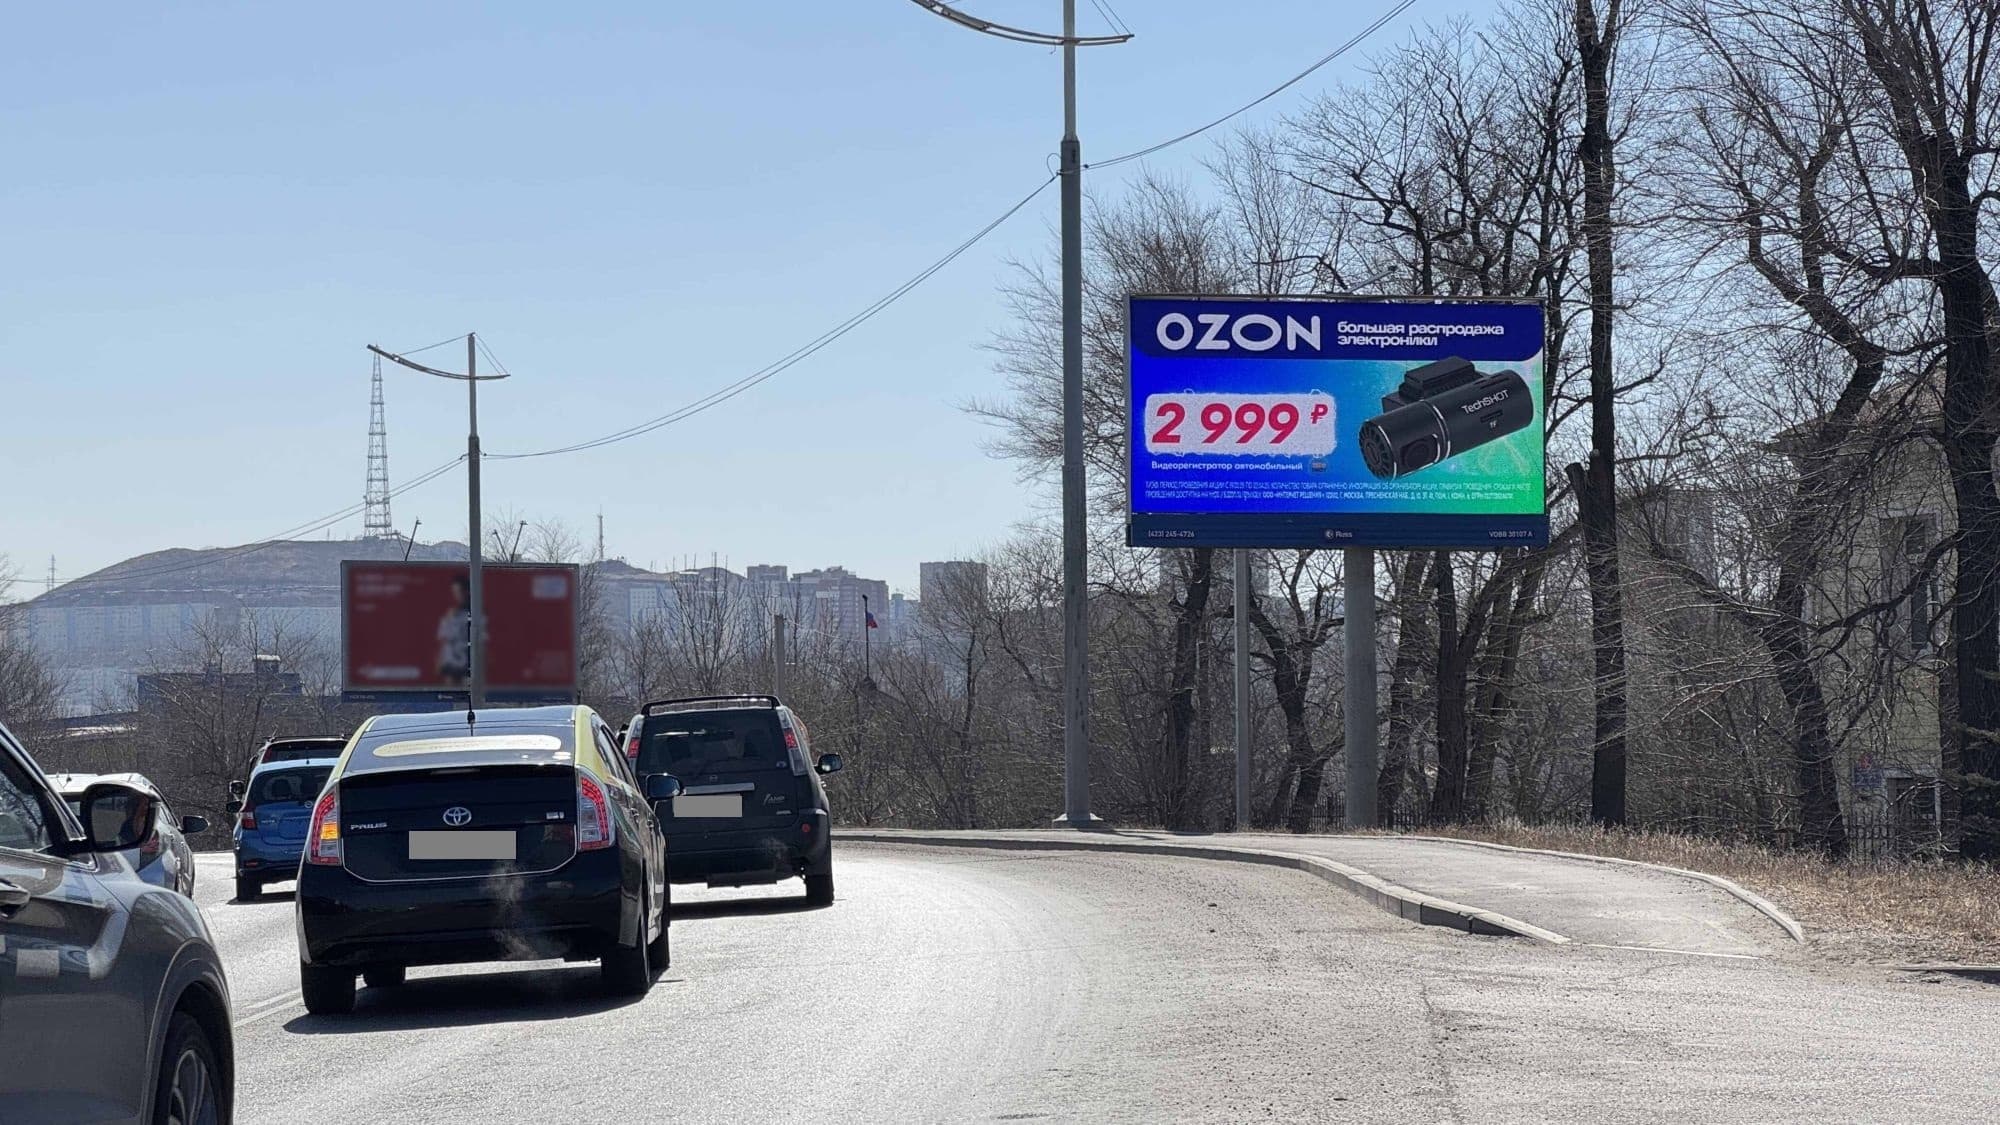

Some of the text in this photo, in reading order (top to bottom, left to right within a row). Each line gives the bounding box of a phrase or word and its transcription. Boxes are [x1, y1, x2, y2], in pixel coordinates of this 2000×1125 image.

[1156, 312, 1321, 351] OZON
[1337, 321, 1505, 337] большая распродажа
[1337, 335, 1438, 348] электроники
[1461, 389, 1509, 414] TechSHOT
[1152, 402, 1186, 443] 2
[1200, 402, 1300, 444] 999
[1151, 460, 1233, 472] Видеорегистратор
[1234, 461, 1303, 471] автомобильный
